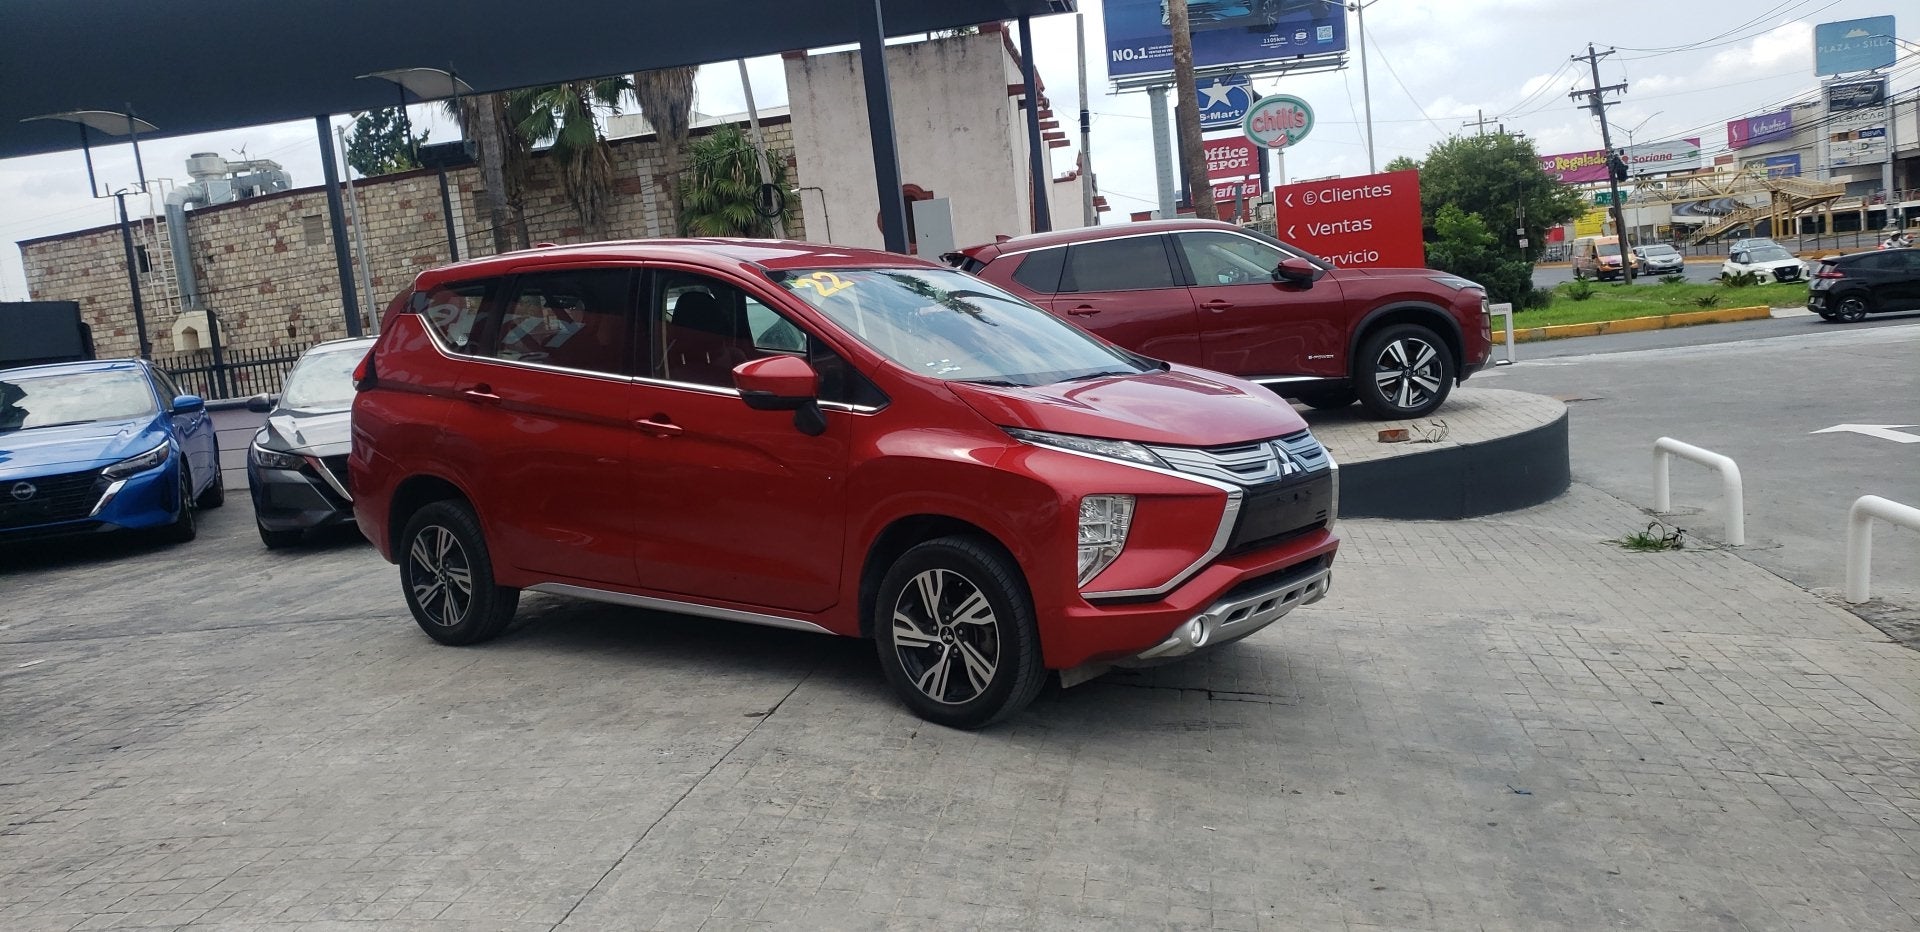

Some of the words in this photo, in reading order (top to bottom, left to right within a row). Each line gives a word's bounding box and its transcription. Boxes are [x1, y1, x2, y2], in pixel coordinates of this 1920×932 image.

[1112, 47, 1148, 61] NO.1
[1252, 105, 1305, 133] chili's
[1861, 129, 1883, 138] BBVA
[1206, 157, 1249, 172] EPOT
[1554, 152, 1607, 172] Regalado
[1632, 152, 1673, 164] Soriana
[1306, 218, 1373, 237] Ventas
[796, 271, 855, 297] 22
